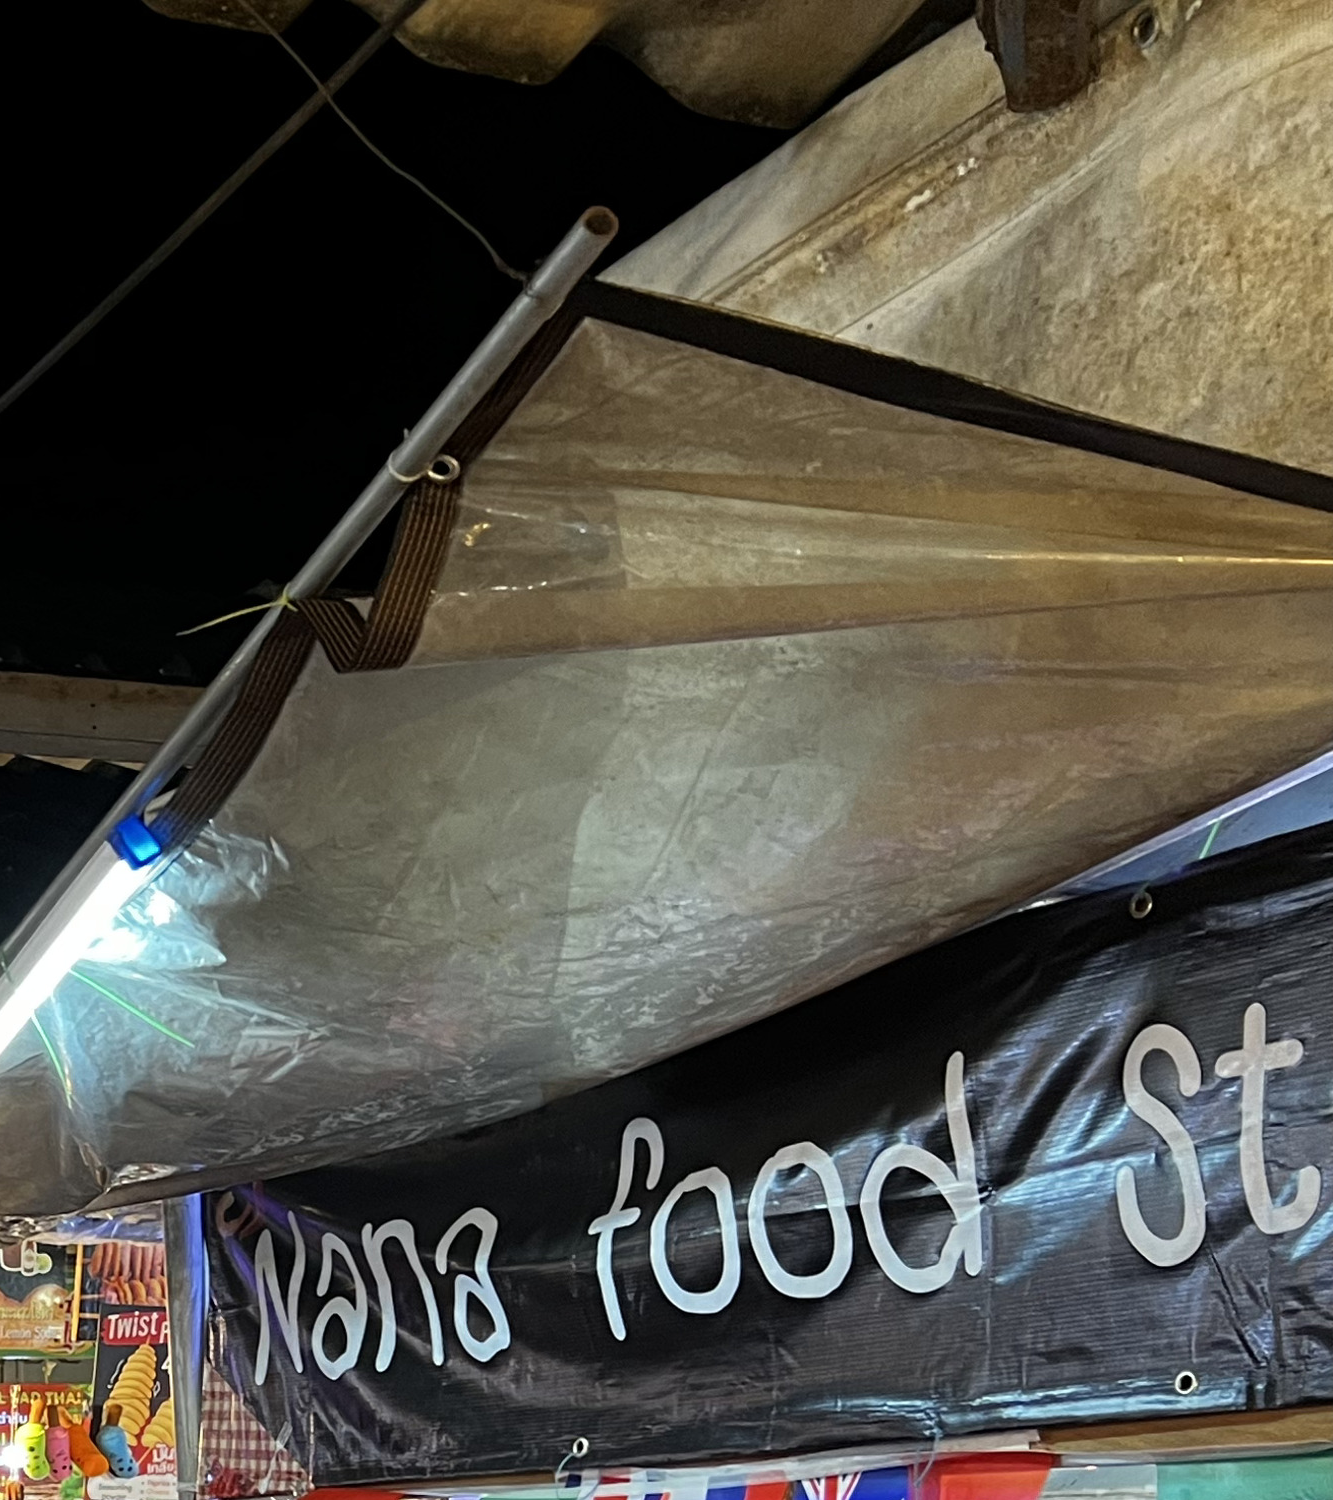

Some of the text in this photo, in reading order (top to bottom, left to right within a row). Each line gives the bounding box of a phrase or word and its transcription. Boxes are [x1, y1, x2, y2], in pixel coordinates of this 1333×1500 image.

[254, 1206, 512, 1386] Nana
[587, 1050, 983, 1341] food
[107, 1312, 160, 1340] Twist
